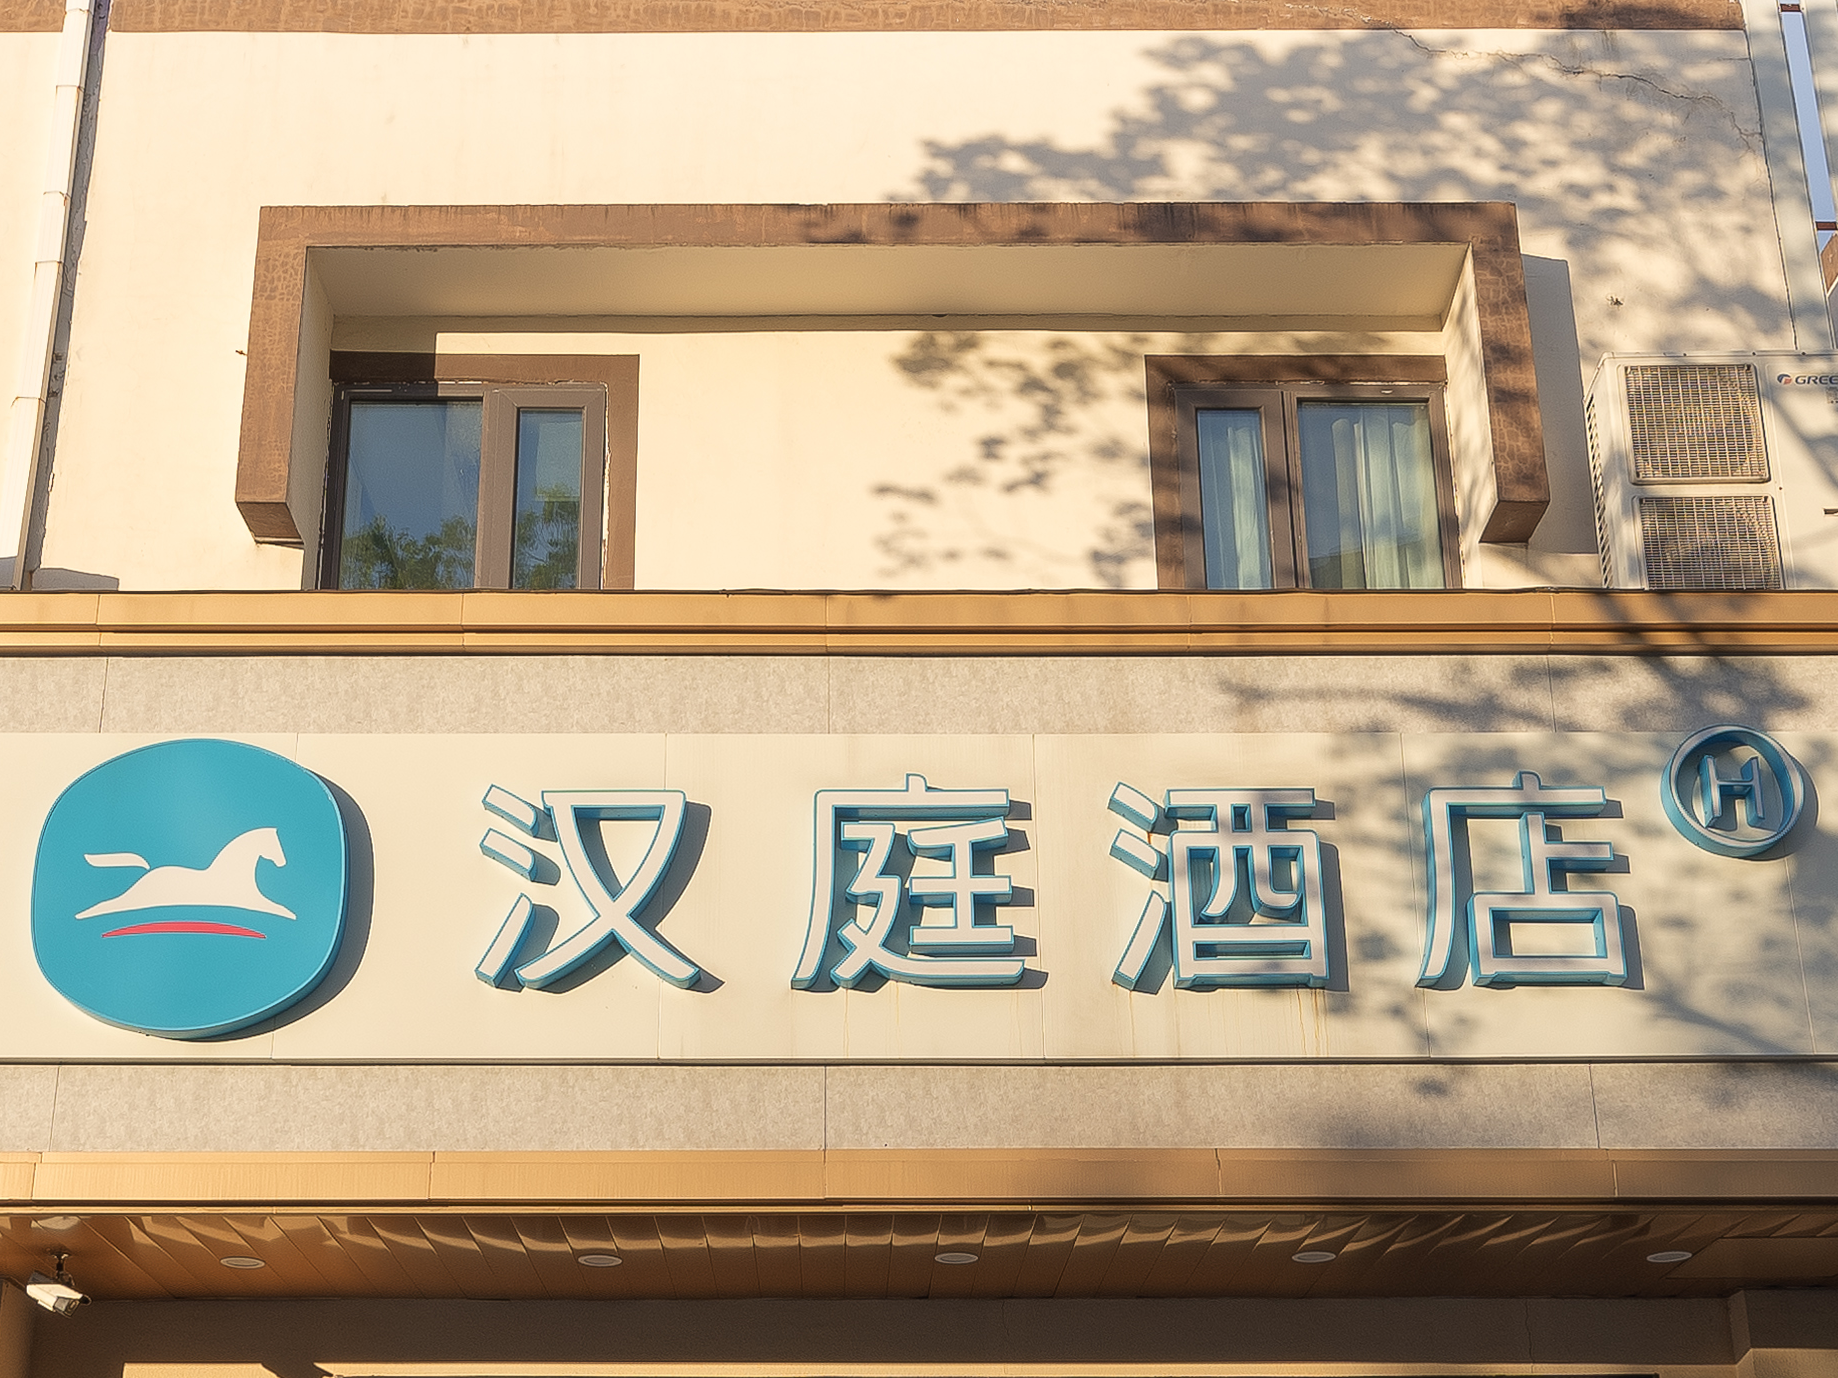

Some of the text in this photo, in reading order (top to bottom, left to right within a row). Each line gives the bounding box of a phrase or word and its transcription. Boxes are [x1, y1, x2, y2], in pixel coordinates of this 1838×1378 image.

[1795, 374, 1838, 386] GREE
[475, 772, 1629, 992] 汉庭酒店
